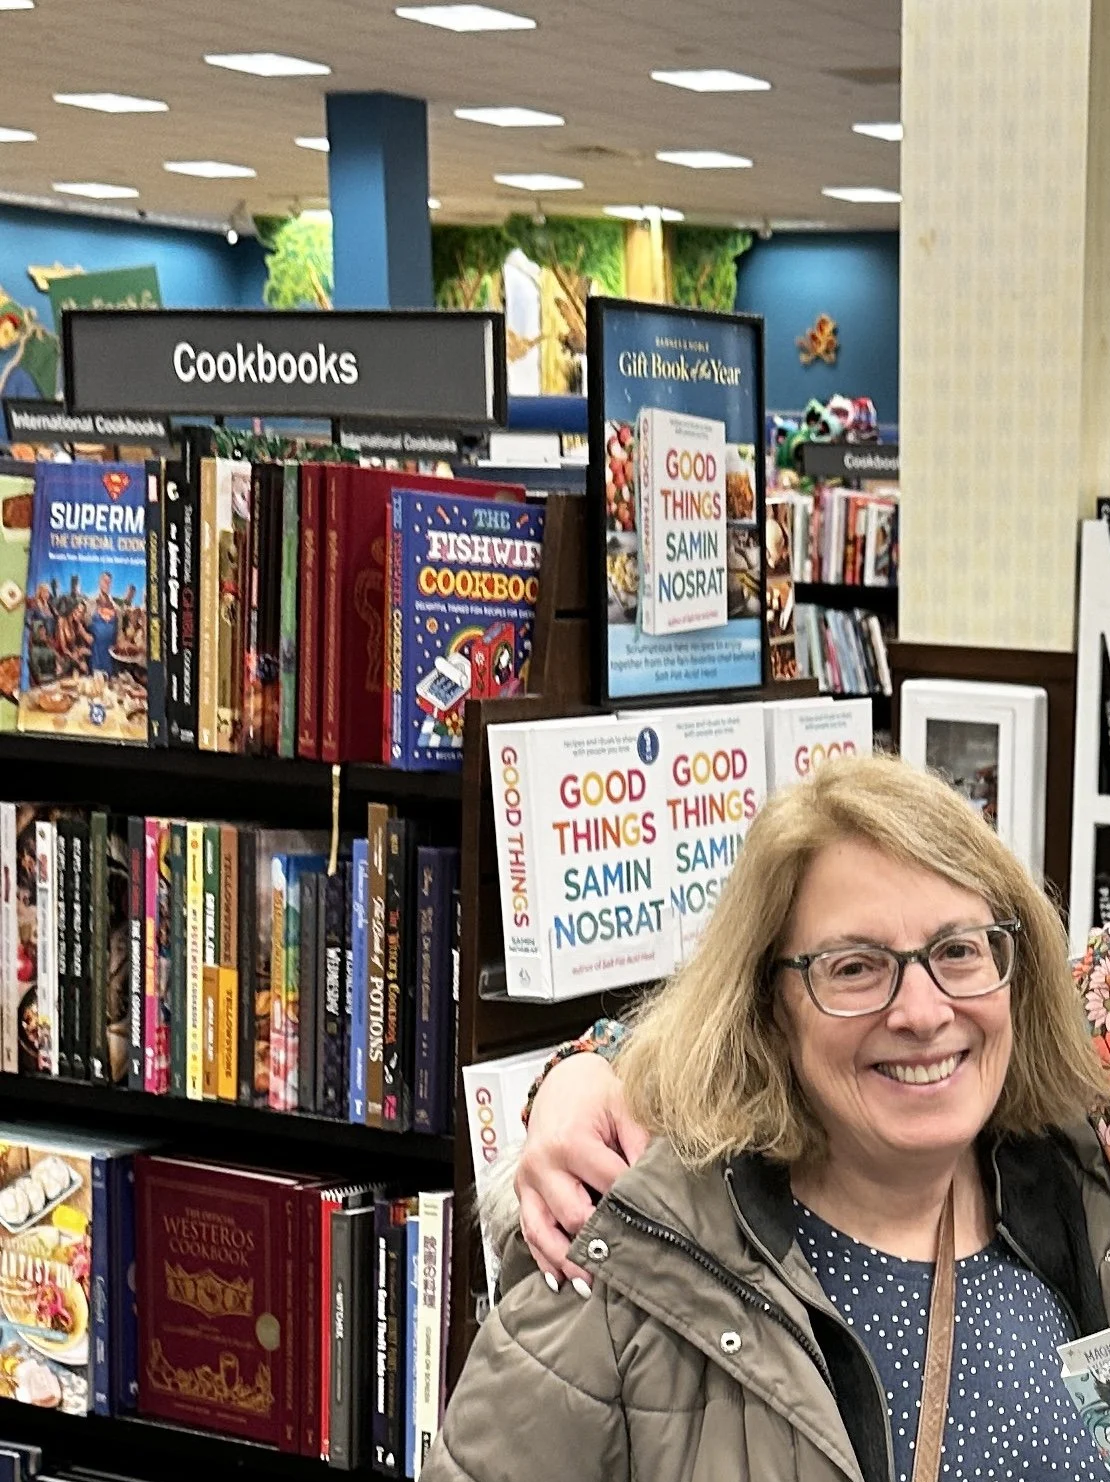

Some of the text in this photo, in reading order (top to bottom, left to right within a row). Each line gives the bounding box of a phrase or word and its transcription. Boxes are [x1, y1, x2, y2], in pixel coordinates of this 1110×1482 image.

[173, 342, 359, 385] Cookbooks
[619, 351, 649, 379] Gift
[651, 352, 690, 382] Book
[710, 357, 742, 386] Year
[12, 410, 167, 437] International Cookbooks
[666, 448, 717, 482] GOOD
[50, 501, 145, 534] SUPERM
[473, 507, 511, 531] THE
[660, 489, 722, 521] THINGS
[665, 531, 719, 562] SAMIN
[658, 567, 725, 605] NOSRAT
[559, 768, 646, 809] GOOD
[672, 747, 748, 788] GOOD
[666, 788, 758, 831] THINGS
[501, 745, 530, 928] GOOD THINGS
[552, 811, 657, 856] THINGS
[563, 857, 653, 902] SAMIN
[669, 876, 729, 919] NOS
[220, 853, 233, 963] YELLOWSTONE
[553, 899, 666, 950] NOSRAT
[326, 946, 341, 1017] WEDNESDAY
[224, 988, 234, 1079] YELLOWSTONE
[368, 974, 385, 1063] POTIONS
[475, 1086, 499, 1165] GOOD
[163, 1214, 256, 1250] WESTEROS
[168, 1238, 249, 1268] COOKBOOK
[377, 1288, 387, 1376] Grand Theft Auto
